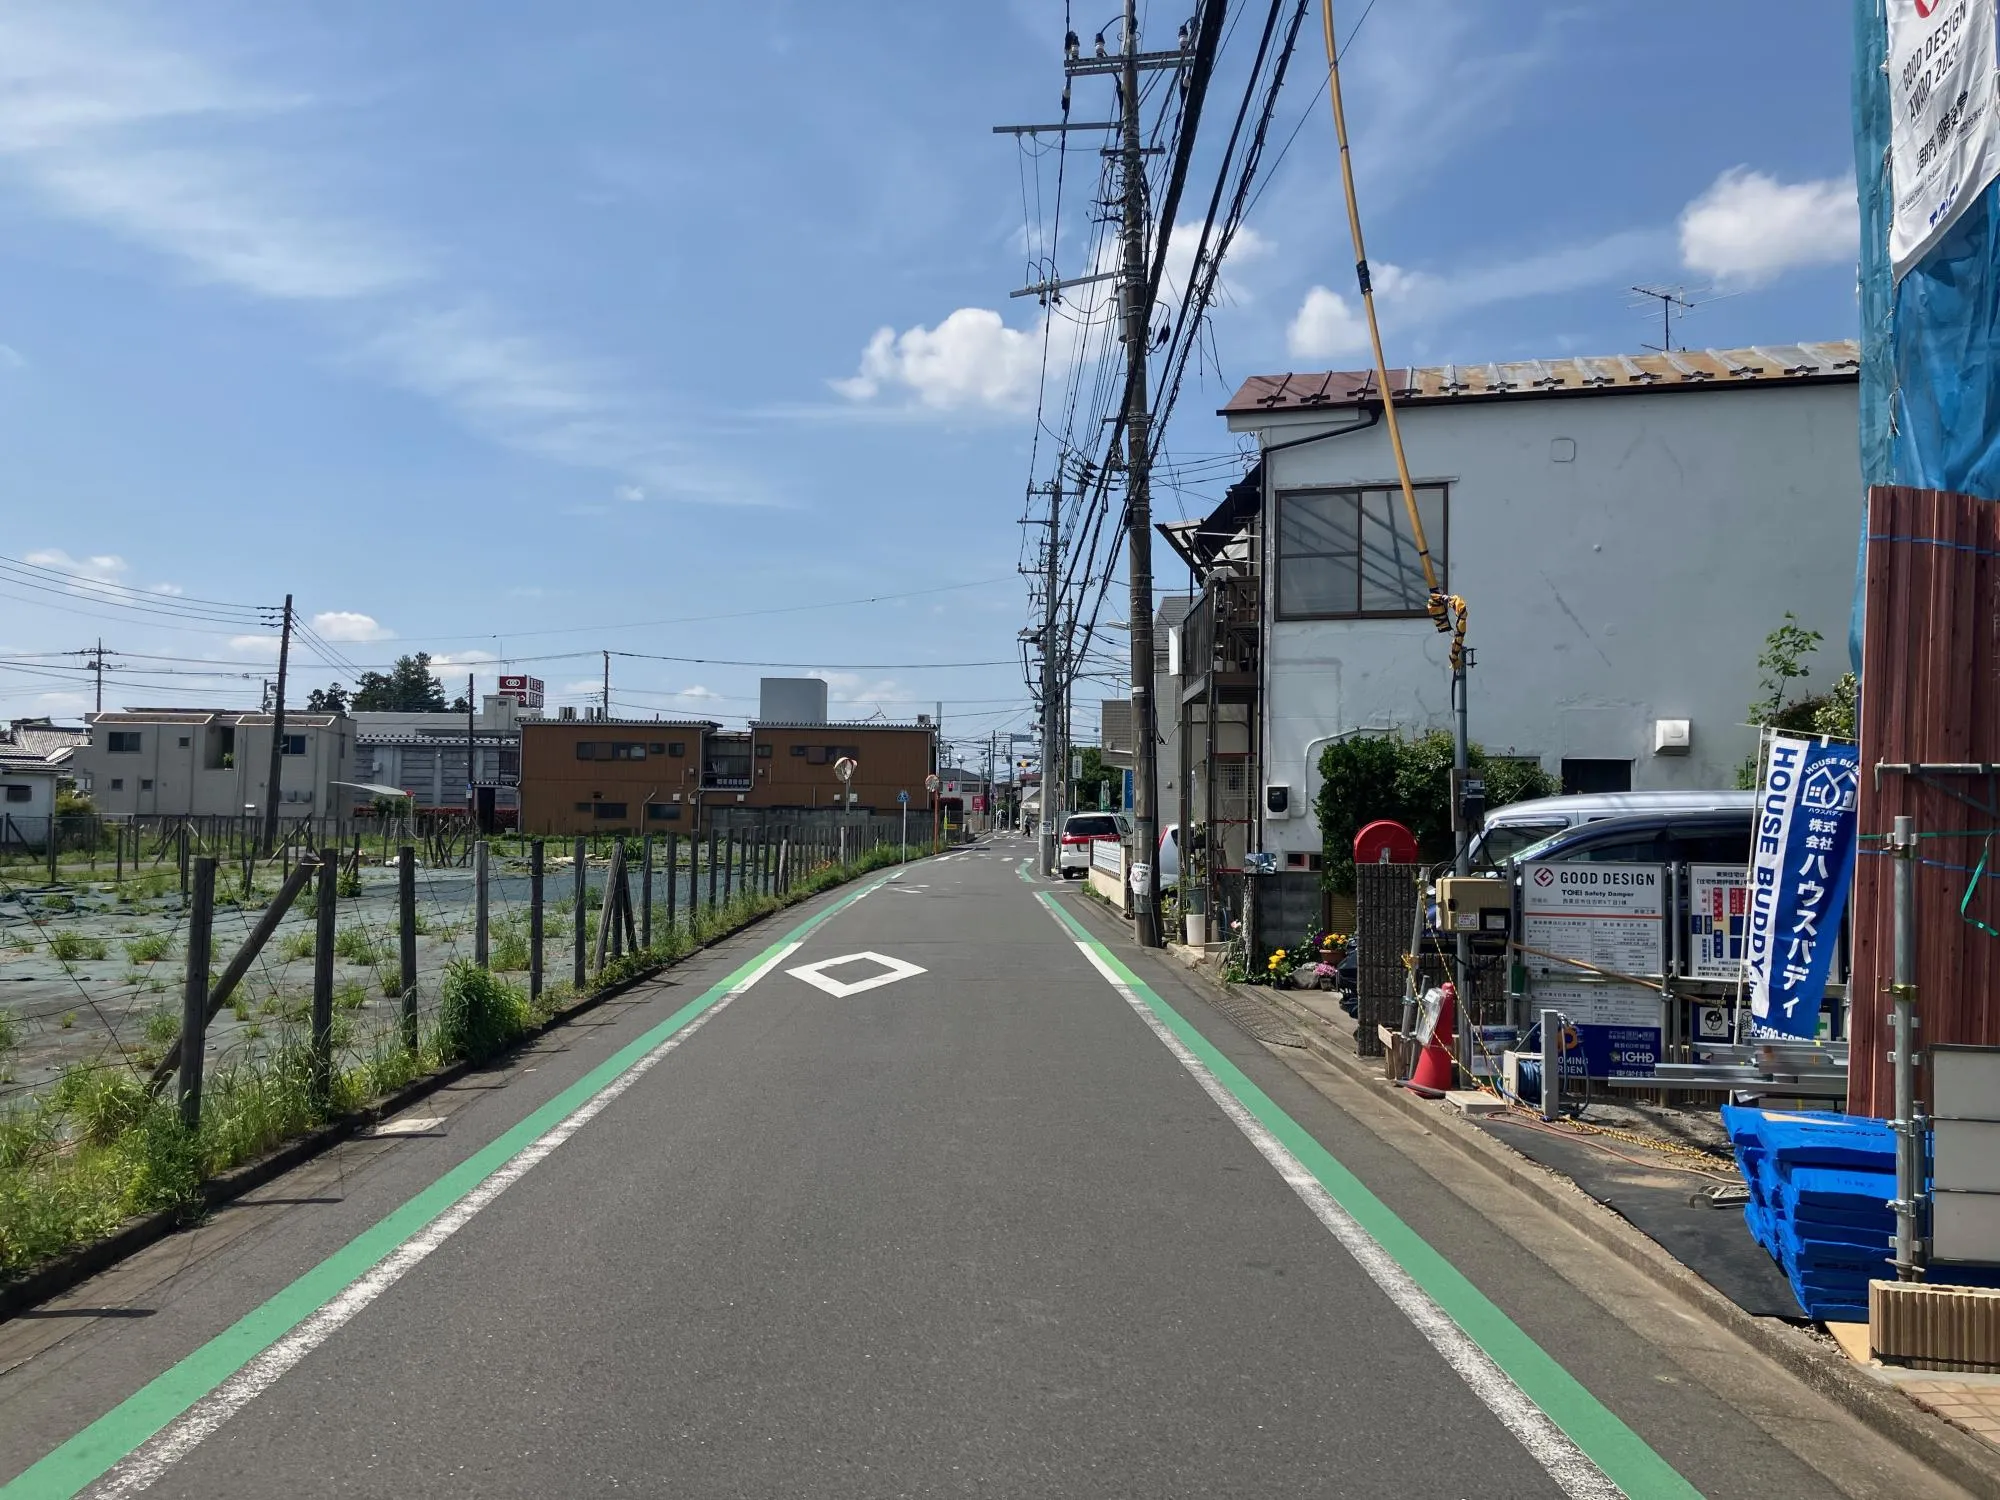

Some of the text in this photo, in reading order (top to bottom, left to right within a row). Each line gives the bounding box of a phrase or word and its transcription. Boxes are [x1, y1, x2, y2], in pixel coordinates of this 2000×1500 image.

[1903, 0, 1966, 92] GOOD DESIGN
[1909, 70, 1931, 122] AWARD
[1805, 757, 1861, 776] HOUSE BUD
[1760, 746, 1798, 856] HOUSE
[1808, 817, 1838, 834] 株式
[1805, 835, 1834, 851] 会社
[1560, 871, 1655, 886] GOOD DESIGN
[1585, 890, 1606, 898] Safety
[1782, 853, 1828, 1018] ハウスバディ
